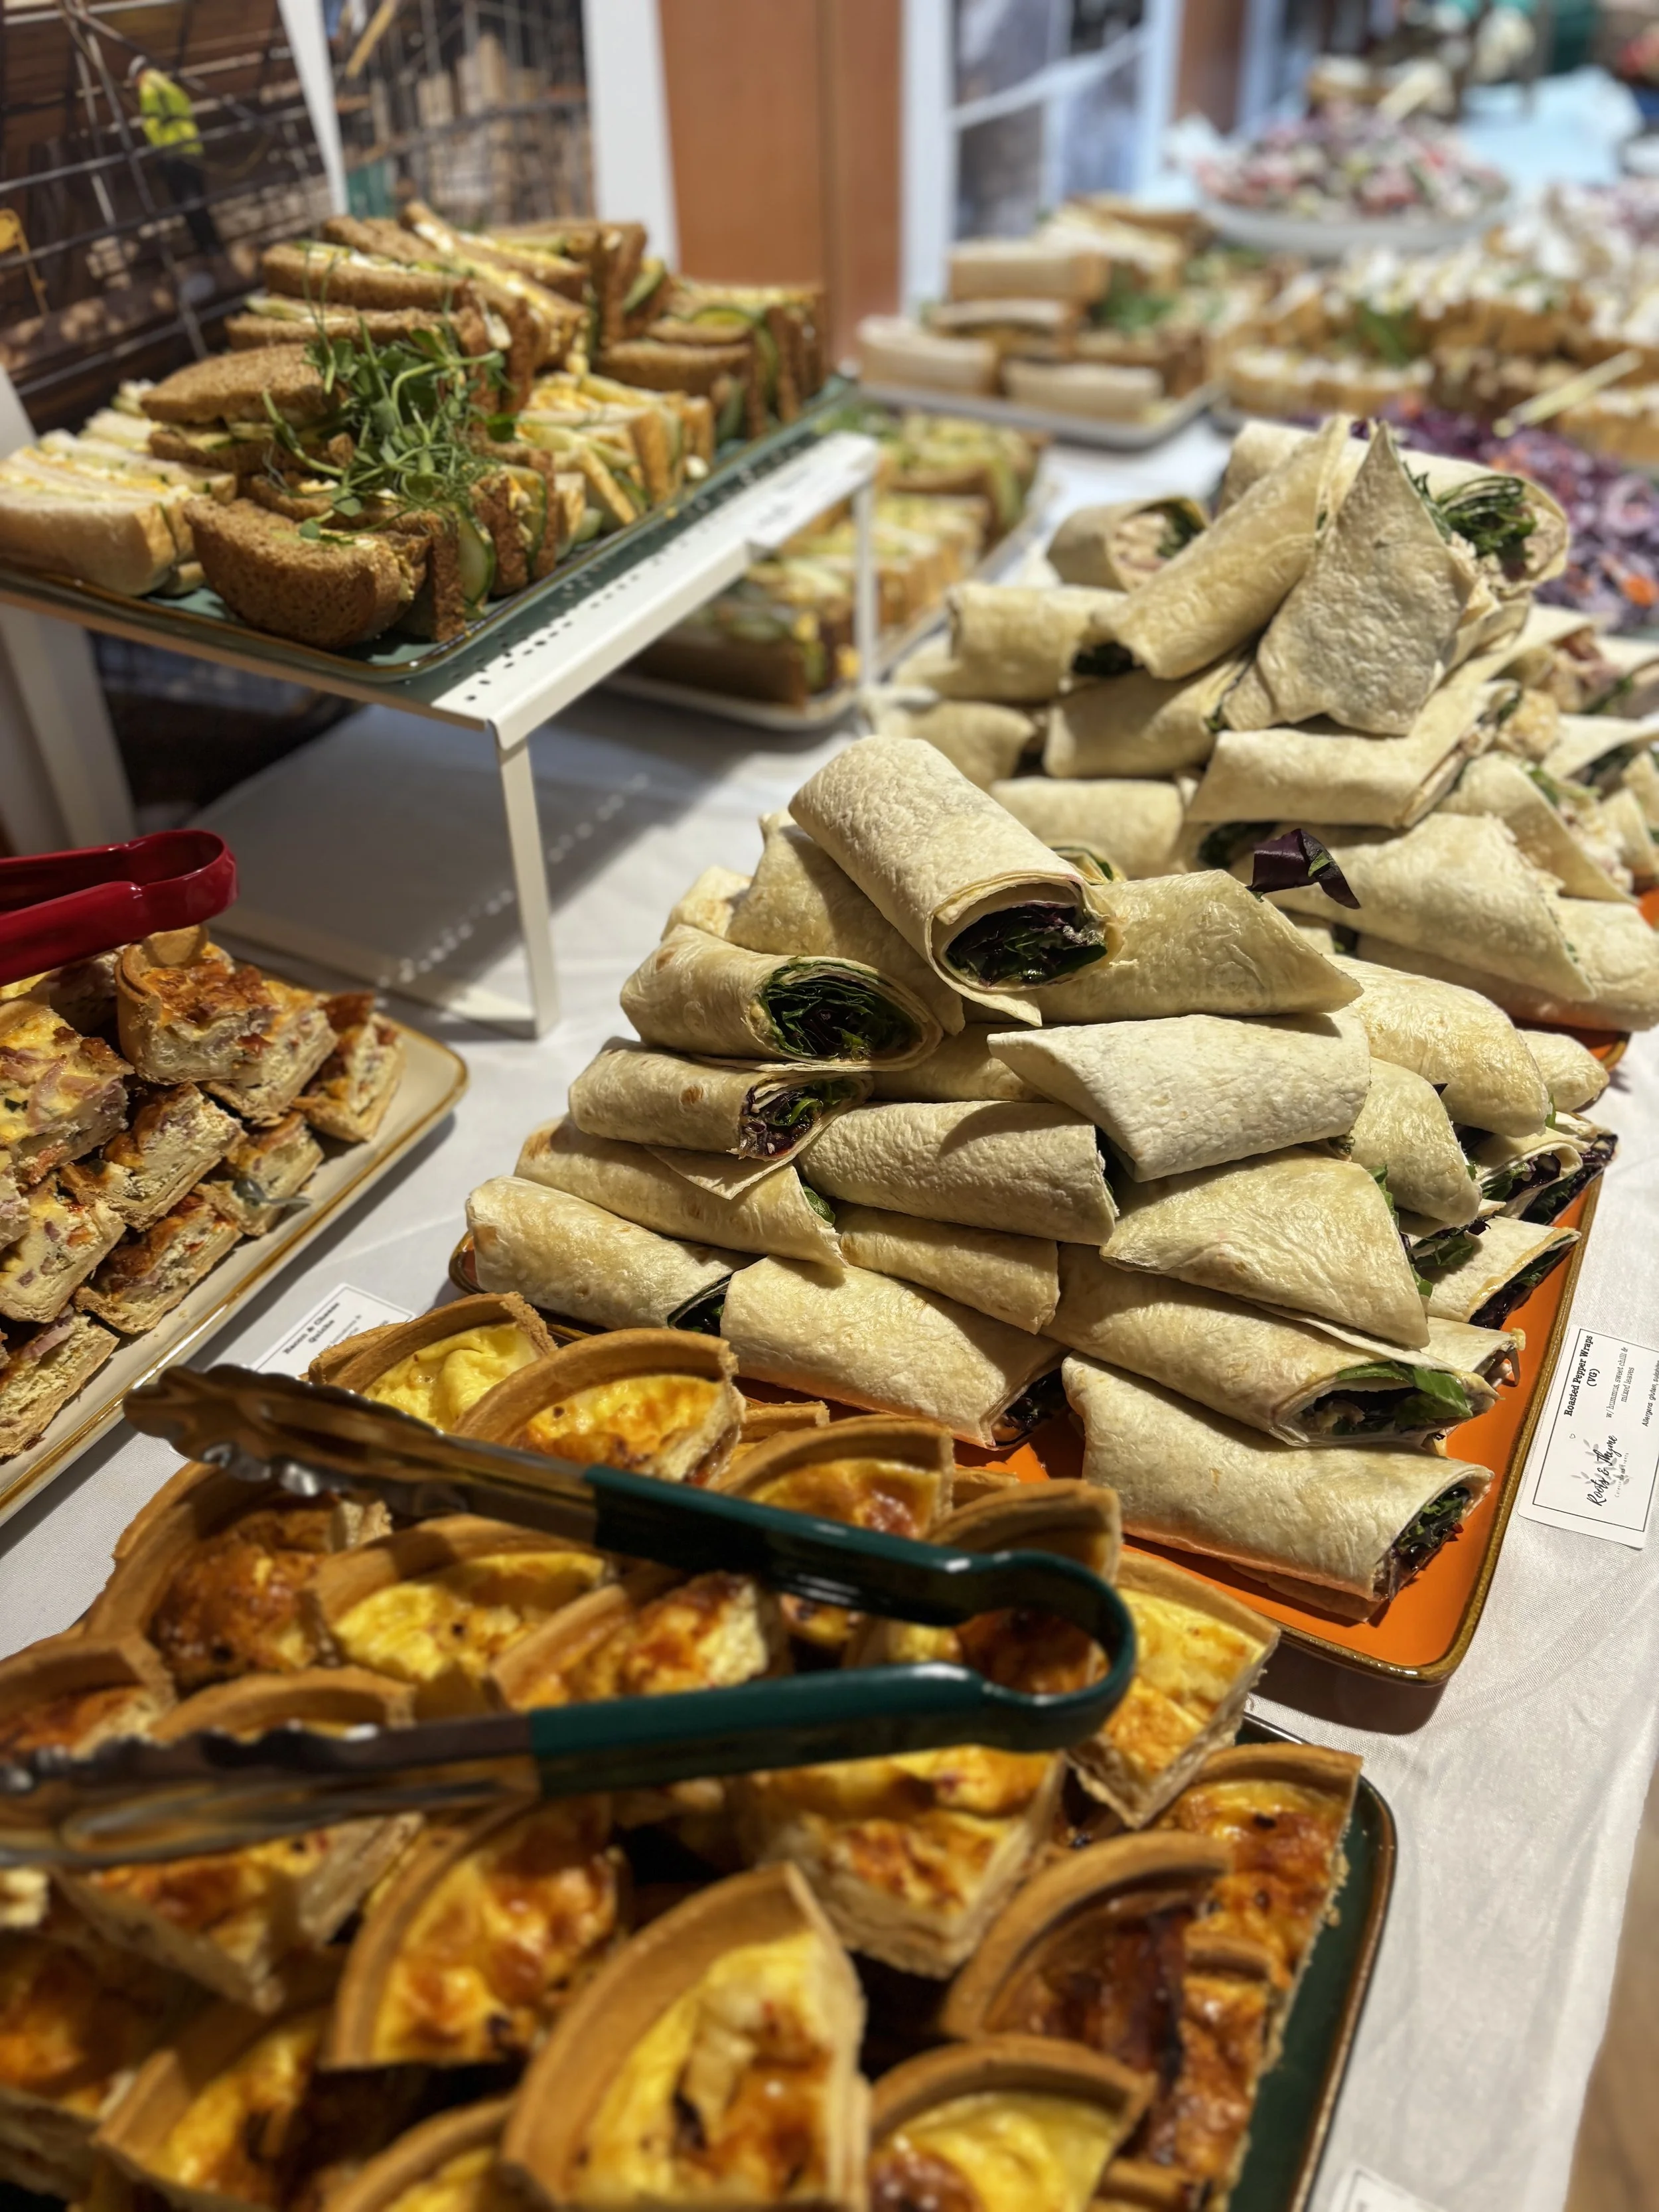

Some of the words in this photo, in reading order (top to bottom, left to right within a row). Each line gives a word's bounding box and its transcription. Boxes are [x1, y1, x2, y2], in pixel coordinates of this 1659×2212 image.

[1579, 1335, 1594, 1358] Wraps
[1618, 1353, 1627, 1367] chilli
[1573, 1359, 1587, 1384] Pepper
[1587, 1368, 1600, 1387] (VG)
[1615, 1366, 1624, 1383] sweet
[1624, 1366, 1635, 1384] leaves
[1563, 1384, 1580, 1417] Roasted
[1621, 1384, 1630, 1402] mixed
[1593, 1435, 1623, 1466] Thyme
[1597, 1467, 1609, 1476] &
[1586, 1477, 1610, 1507] Roots
